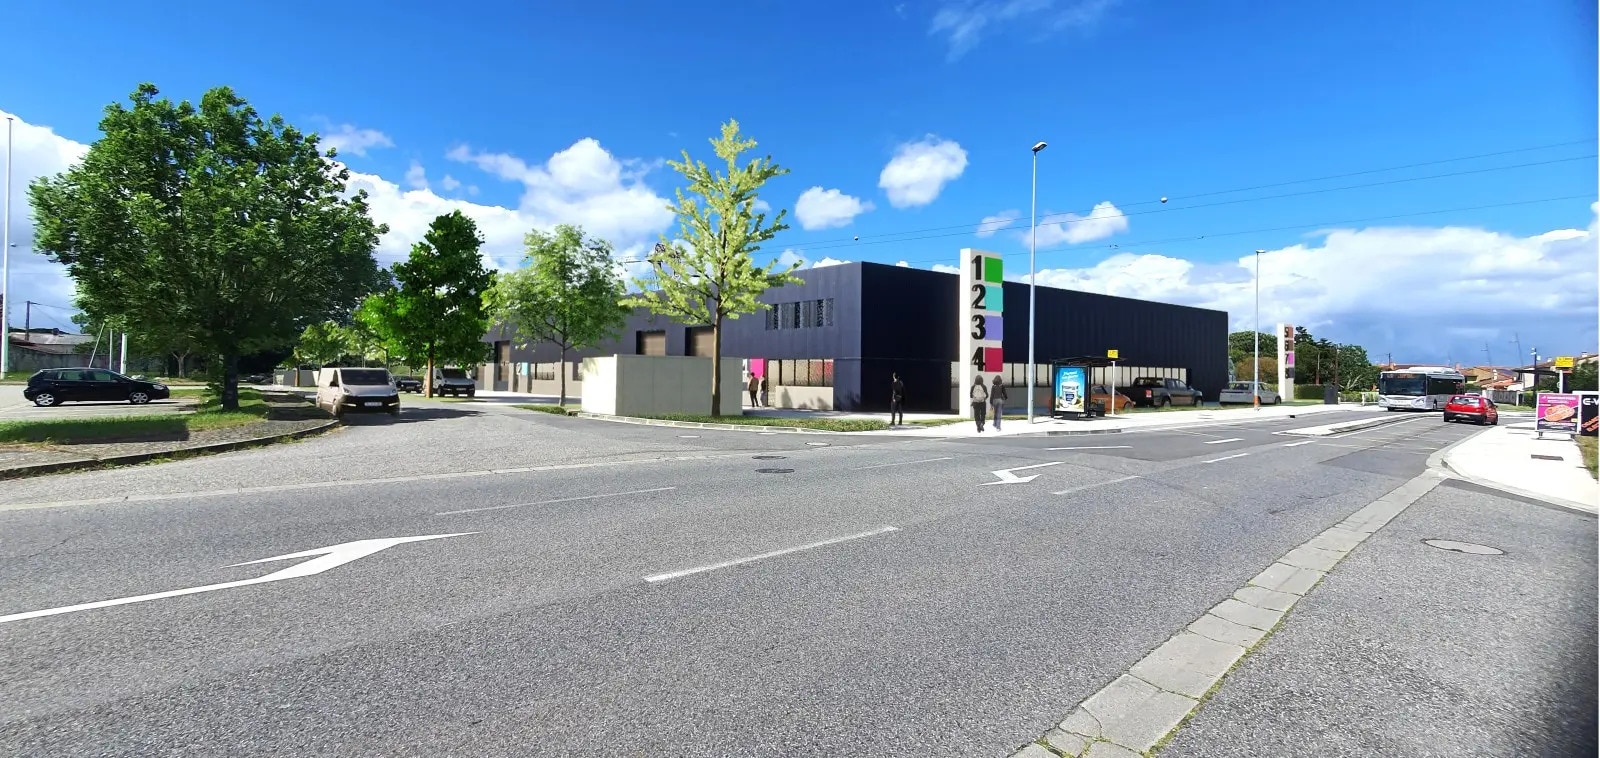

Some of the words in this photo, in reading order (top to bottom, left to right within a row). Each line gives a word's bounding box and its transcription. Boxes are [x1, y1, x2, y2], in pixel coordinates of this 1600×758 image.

[971, 254, 982, 280] 1
[971, 284, 987, 310] 2
[971, 314, 987, 340] 3
[971, 346, 986, 372] 4
